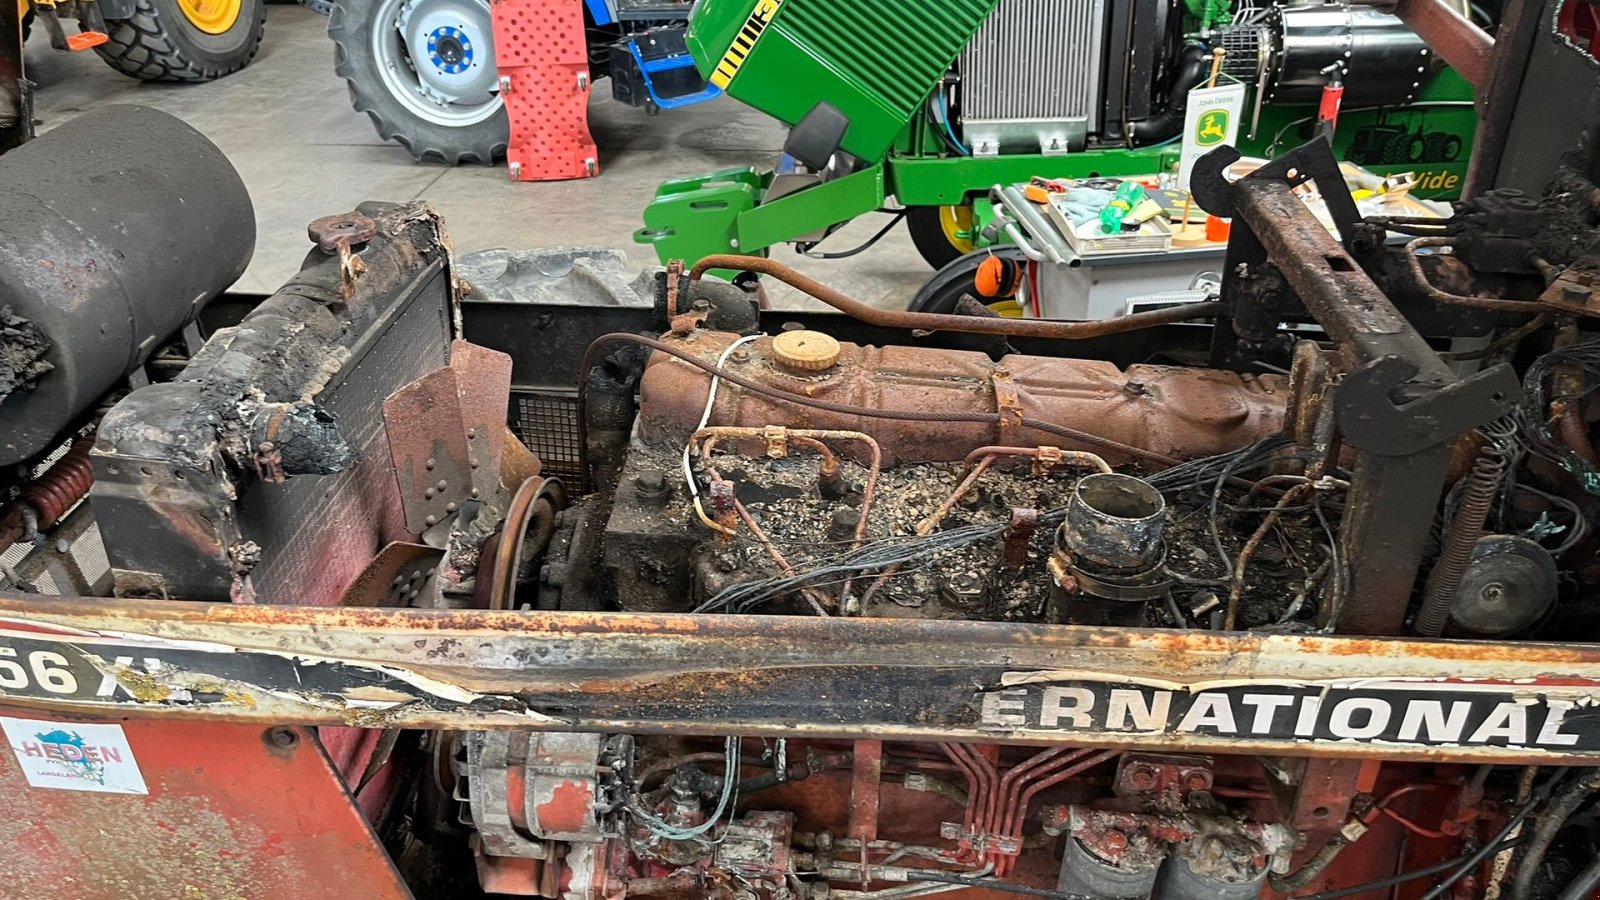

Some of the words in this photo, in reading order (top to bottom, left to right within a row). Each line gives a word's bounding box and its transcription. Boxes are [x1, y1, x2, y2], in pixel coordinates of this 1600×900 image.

[1197, 99, 1214, 107] JOHN
[1215, 96, 1234, 104] DEERE
[21, 740, 123, 763] HEDEN
